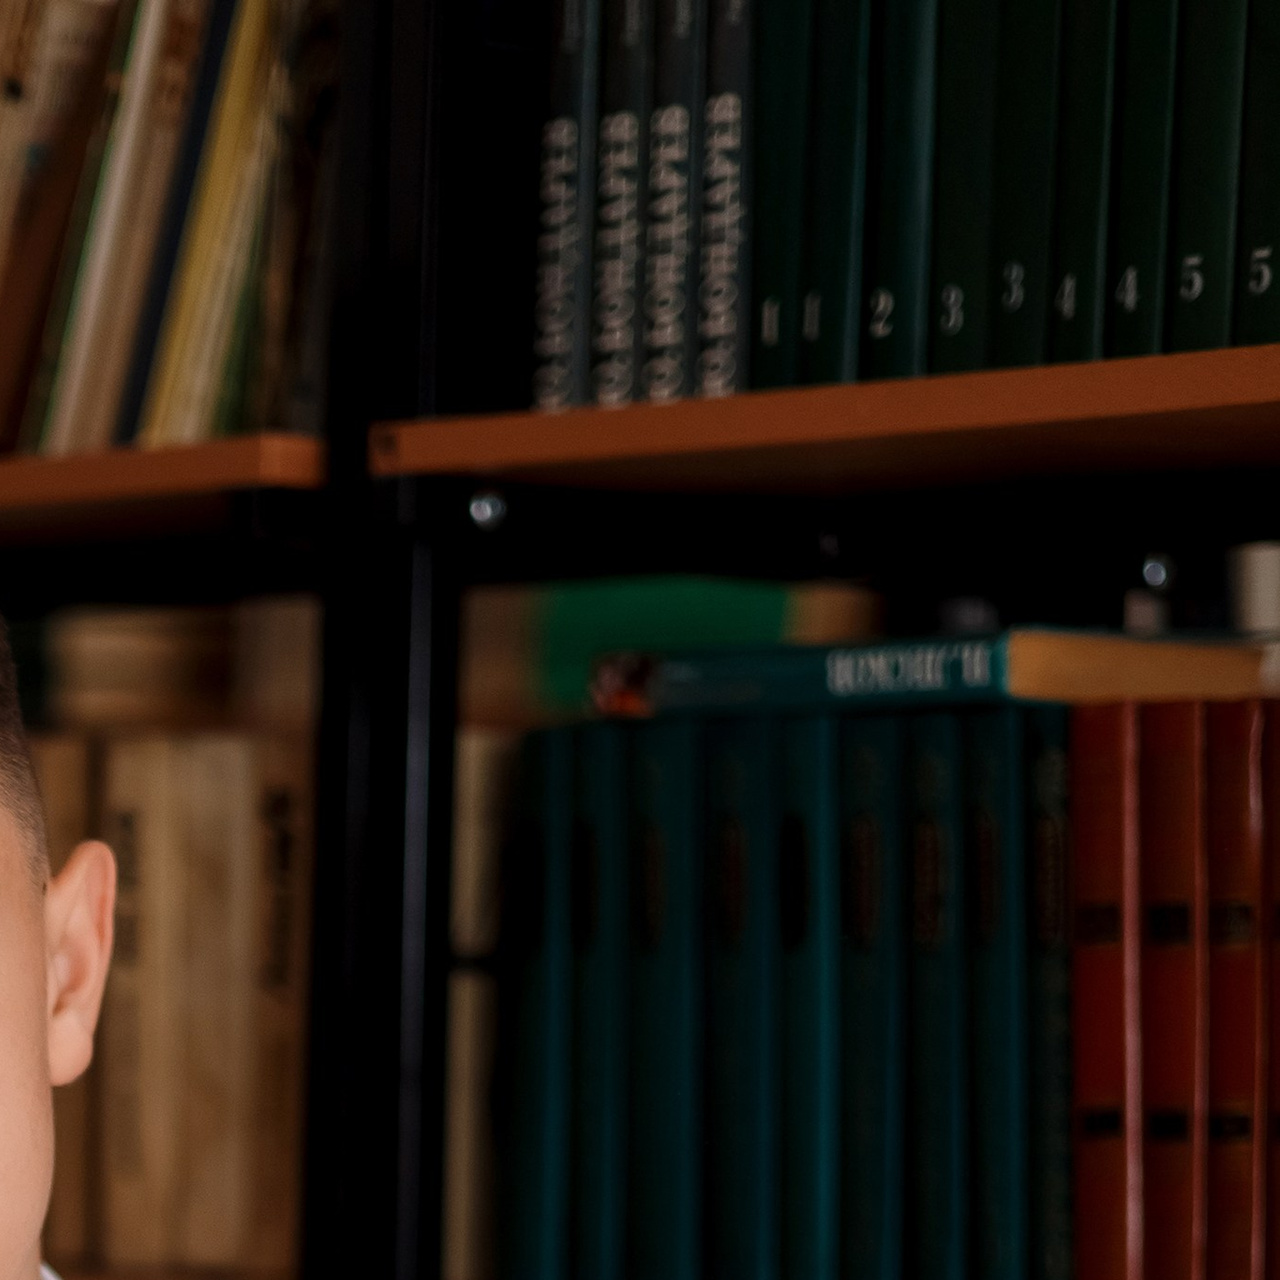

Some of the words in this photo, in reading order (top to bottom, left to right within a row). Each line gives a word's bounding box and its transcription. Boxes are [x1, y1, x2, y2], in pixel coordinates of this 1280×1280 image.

[1001, 260, 1026, 312] 3
[1115, 265, 1139, 313] 4
[1179, 254, 1204, 303] 5
[1247, 245, 1273, 295] 5
[868, 286, 895, 339] 2
[940, 284, 965, 335] 3
[1054, 272, 1078, 321] 4
